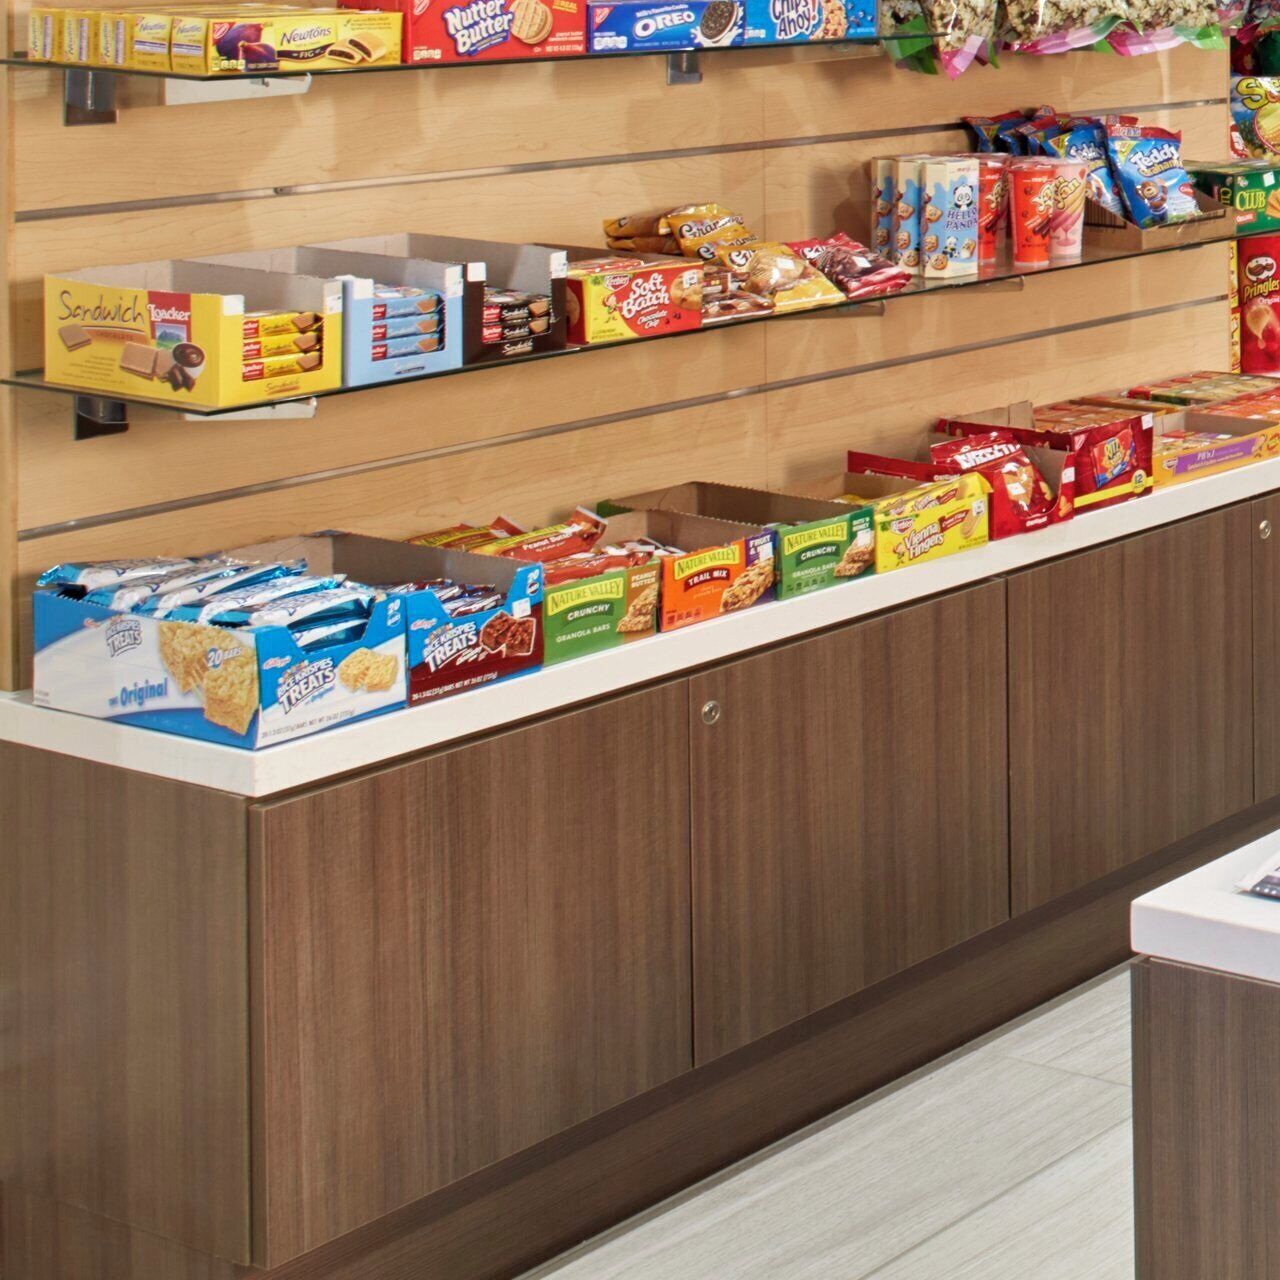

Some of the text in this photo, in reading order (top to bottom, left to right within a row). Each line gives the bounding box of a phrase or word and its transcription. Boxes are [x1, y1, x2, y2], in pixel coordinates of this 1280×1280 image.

[280, 25, 332, 46] Newtons
[455, 12, 513, 53] Butter
[633, 11, 696, 39] OREO
[299, 49, 315, 59] FIG
[1130, 142, 1181, 168] Teddy
[1235, 190, 1266, 211] CLUB
[944, 219, 978, 231] PANDA
[947, 208, 978, 221] HELLO
[630, 272, 664, 298] Soft
[1243, 277, 1280, 299] Pringles
[58, 289, 145, 324] Sandwich
[146, 303, 191, 321] Loacker
[622, 287, 670, 318] Batch
[522, 537, 549, 552] Peanut
[749, 536, 771, 548] FRUIT
[787, 523, 845, 550] NATURE VALLEY
[904, 522, 940, 548] Vienna
[801, 545, 837, 561] CRUNCHY
[910, 533, 944, 560] Fingers
[676, 545, 738, 577] NATURE VALLEY
[631, 570, 657, 583] PEANUT
[688, 569, 728, 587] TRAIL MIX
[548, 579, 623, 611] NATURE VALLEY
[567, 604, 611, 621] CRUNCHY
[107, 630, 143, 653] TREATS
[556, 623, 611, 644] GRANOLA BARS
[207, 651, 223, 668] 20
[425, 632, 478, 673] TREATS
[120, 680, 168, 707] Original
[280, 668, 336, 714] TREATS
